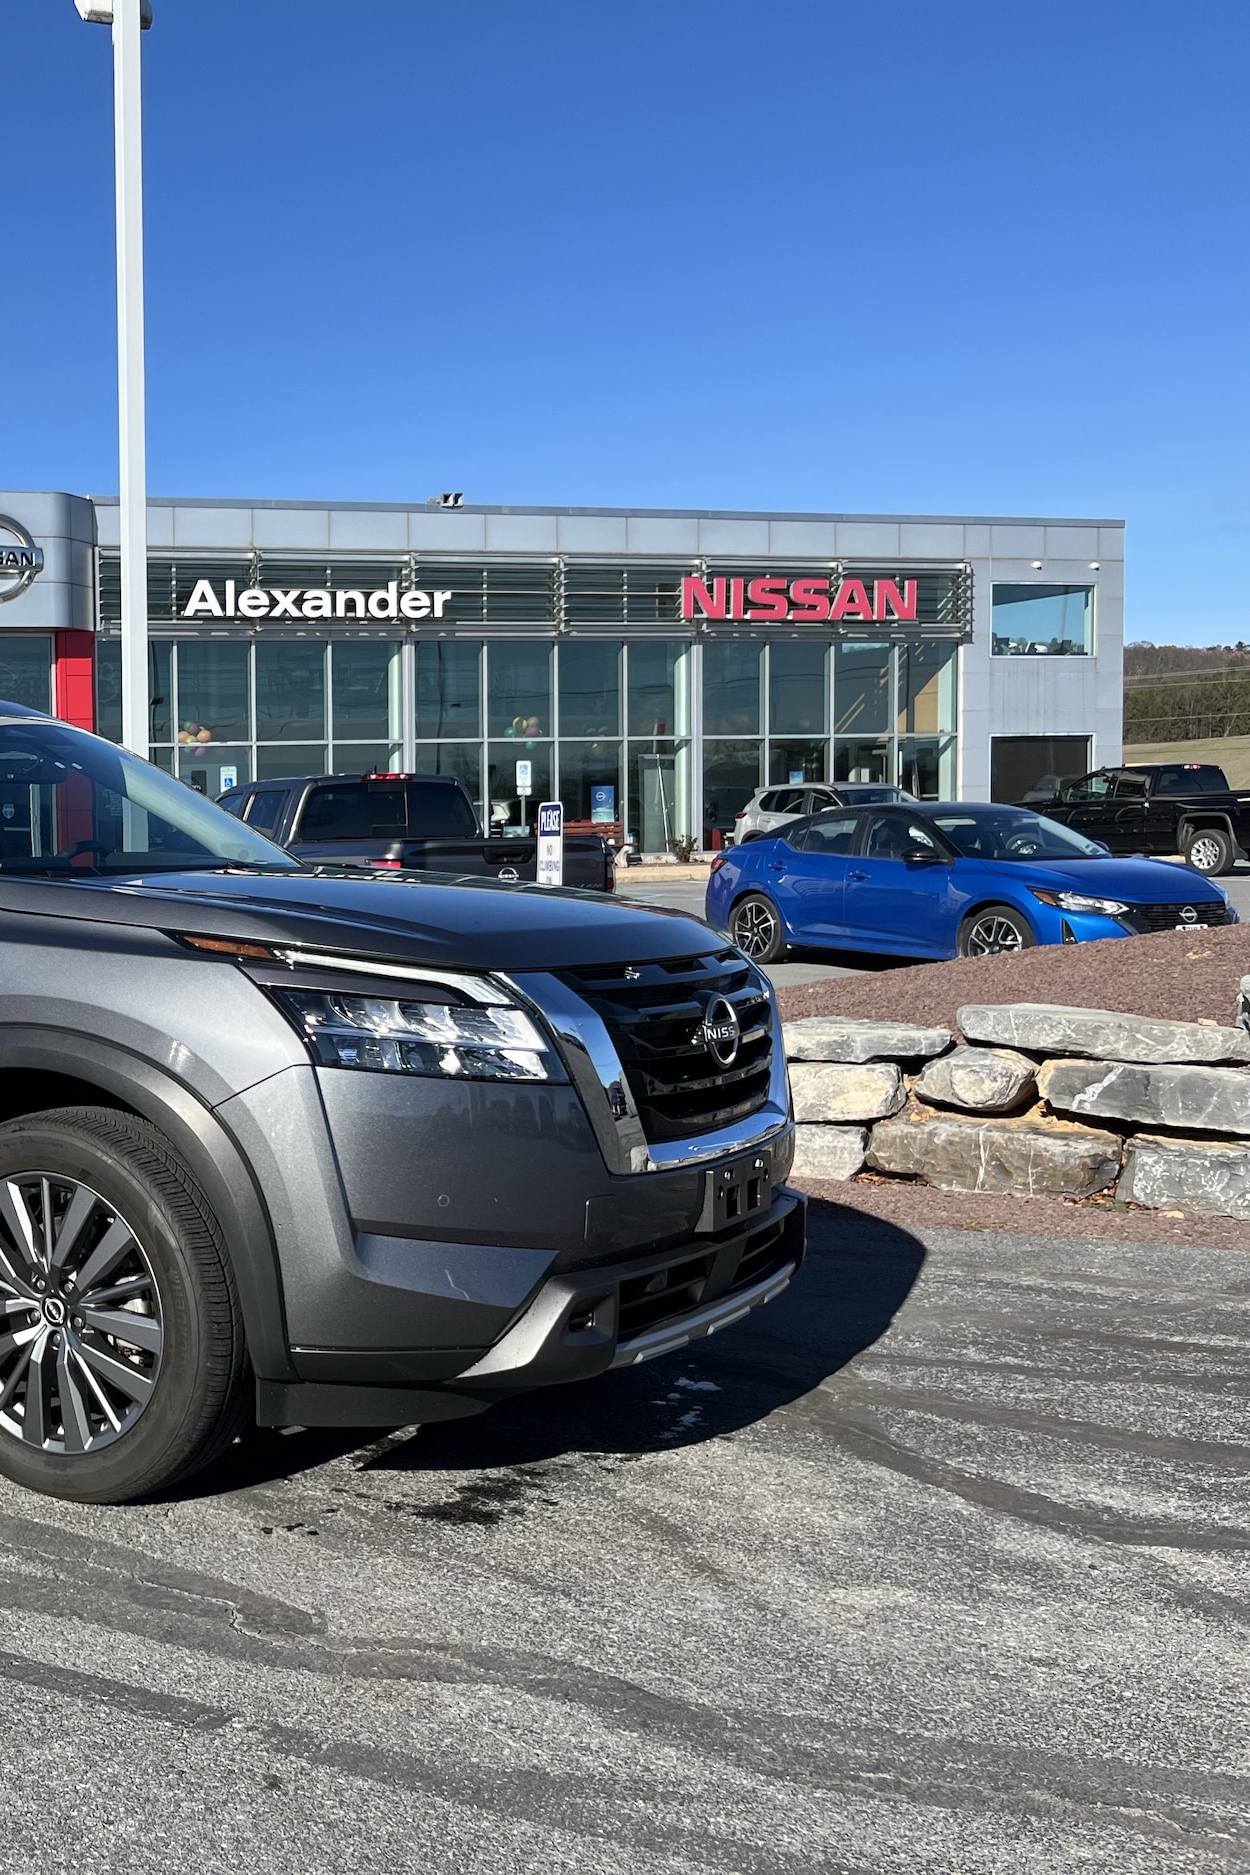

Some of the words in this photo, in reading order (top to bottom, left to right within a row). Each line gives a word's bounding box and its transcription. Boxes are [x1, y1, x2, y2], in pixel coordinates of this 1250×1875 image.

[183, 579, 451, 618] Alexander
[681, 577, 917, 620] NISSAN
[541, 811, 560, 831] PLEASE
[707, 1026, 735, 1040] NISS
